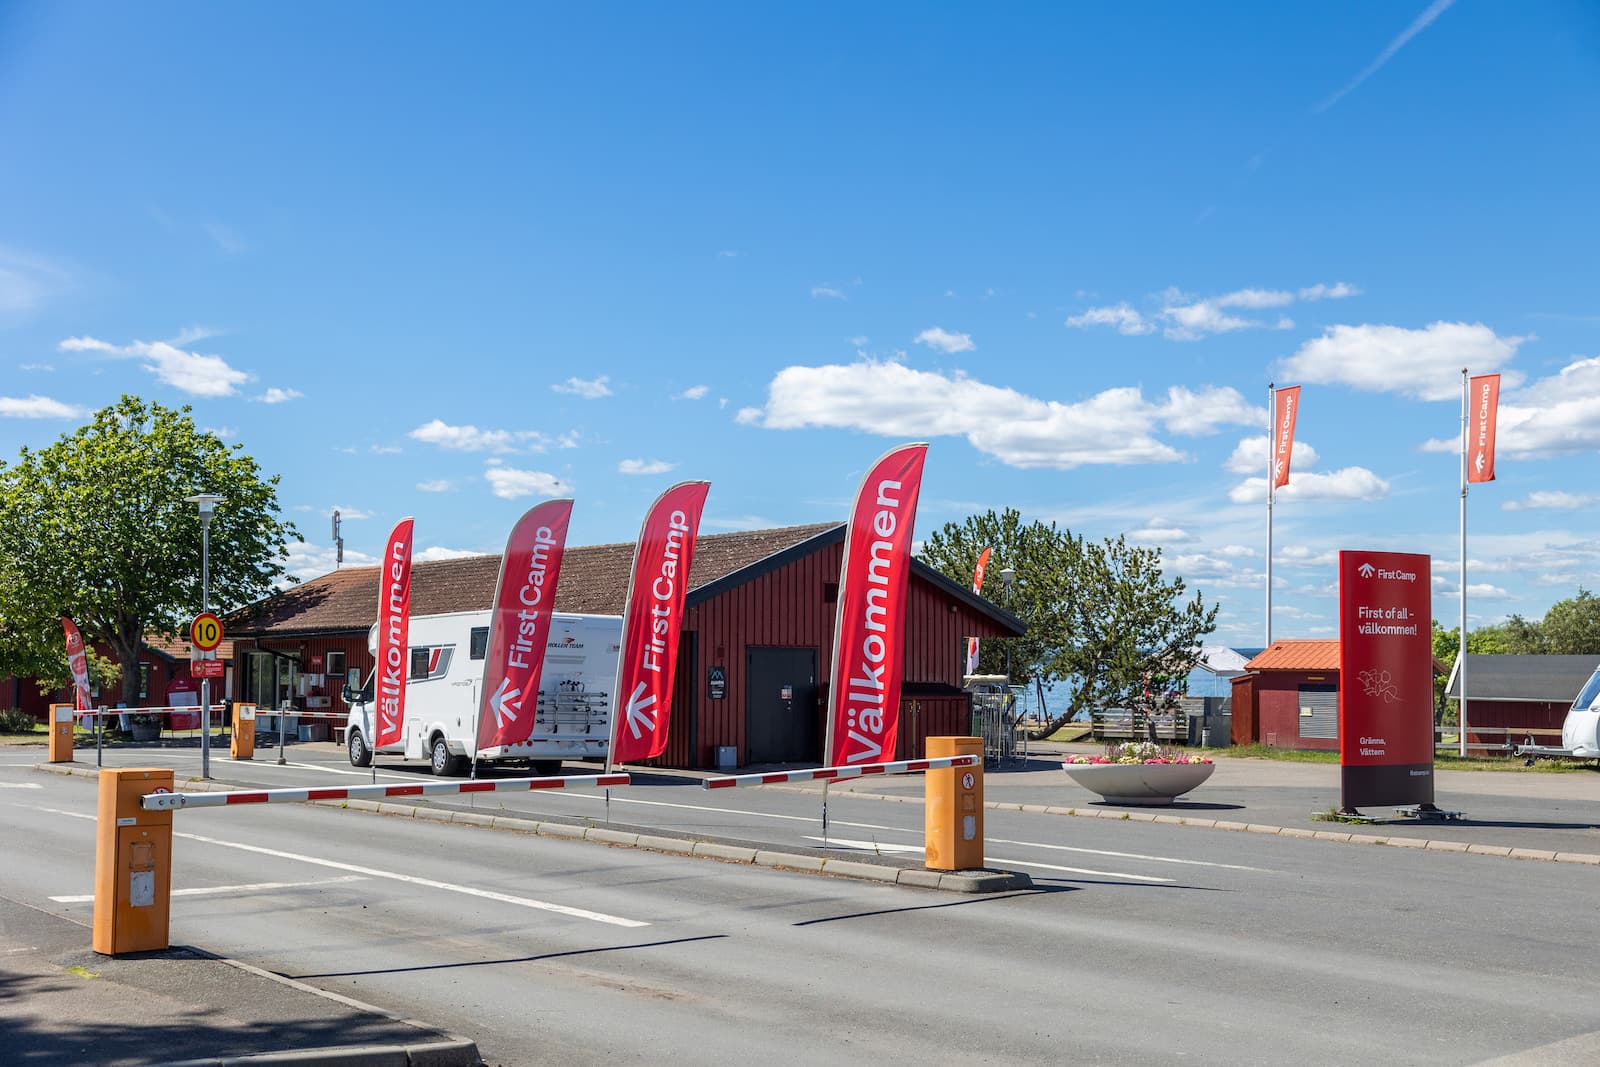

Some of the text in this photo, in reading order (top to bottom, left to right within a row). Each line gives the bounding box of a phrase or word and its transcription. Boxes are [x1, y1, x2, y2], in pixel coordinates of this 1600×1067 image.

[1279, 396, 1293, 453] First Camp
[1479, 384, 1490, 446] First Camp
[508, 526, 557, 669] First Camp
[643, 510, 689, 673] First Camp
[1378, 569, 1416, 583] First Camp
[198, 623, 216, 641] 10
[381, 540, 404, 735] Välkommen
[846, 479, 902, 763] Välkommen
[1358, 606, 1383, 619] First
[1385, 607, 1396, 619] of
[1397, 608, 1408, 620] all
[1358, 622, 1417, 635] välkommen!
